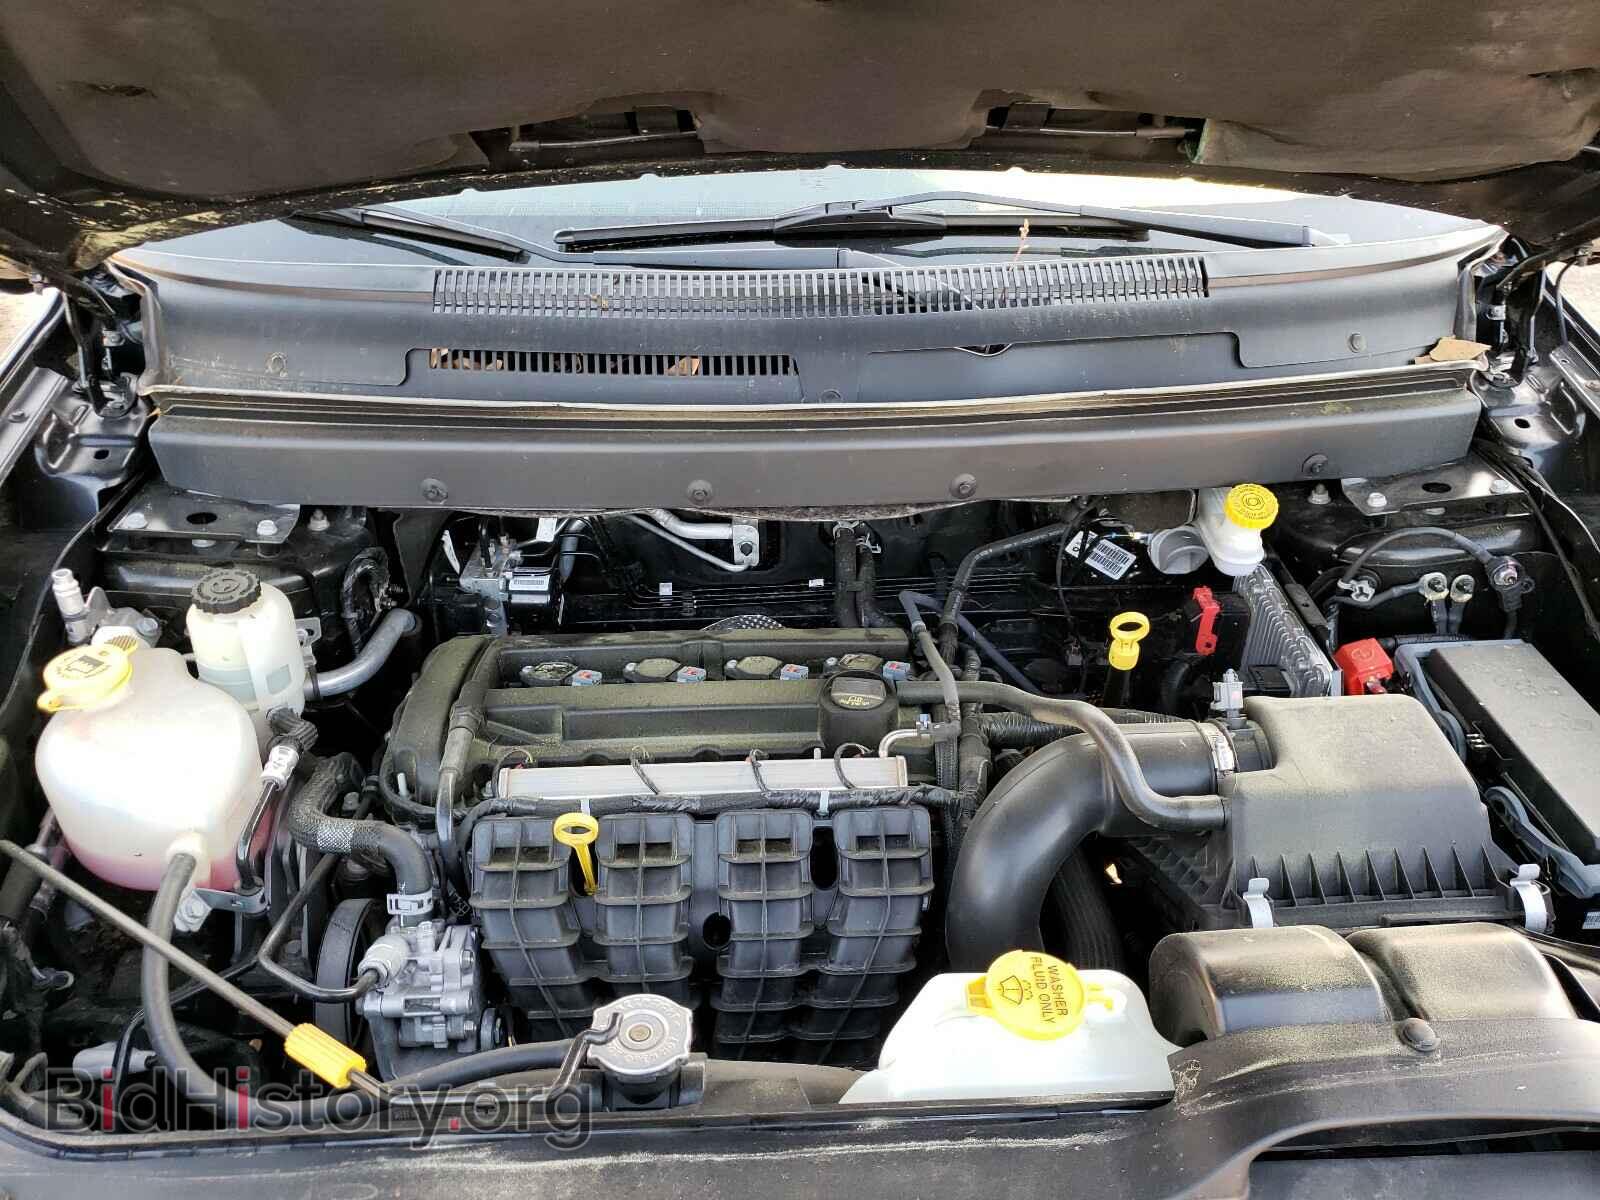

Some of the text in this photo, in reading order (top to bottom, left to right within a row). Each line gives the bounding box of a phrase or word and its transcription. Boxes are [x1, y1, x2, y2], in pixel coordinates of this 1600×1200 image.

[1031, 957, 1056, 1023] FLUID ONLY
[1048, 965, 1068, 1016] WASHER
